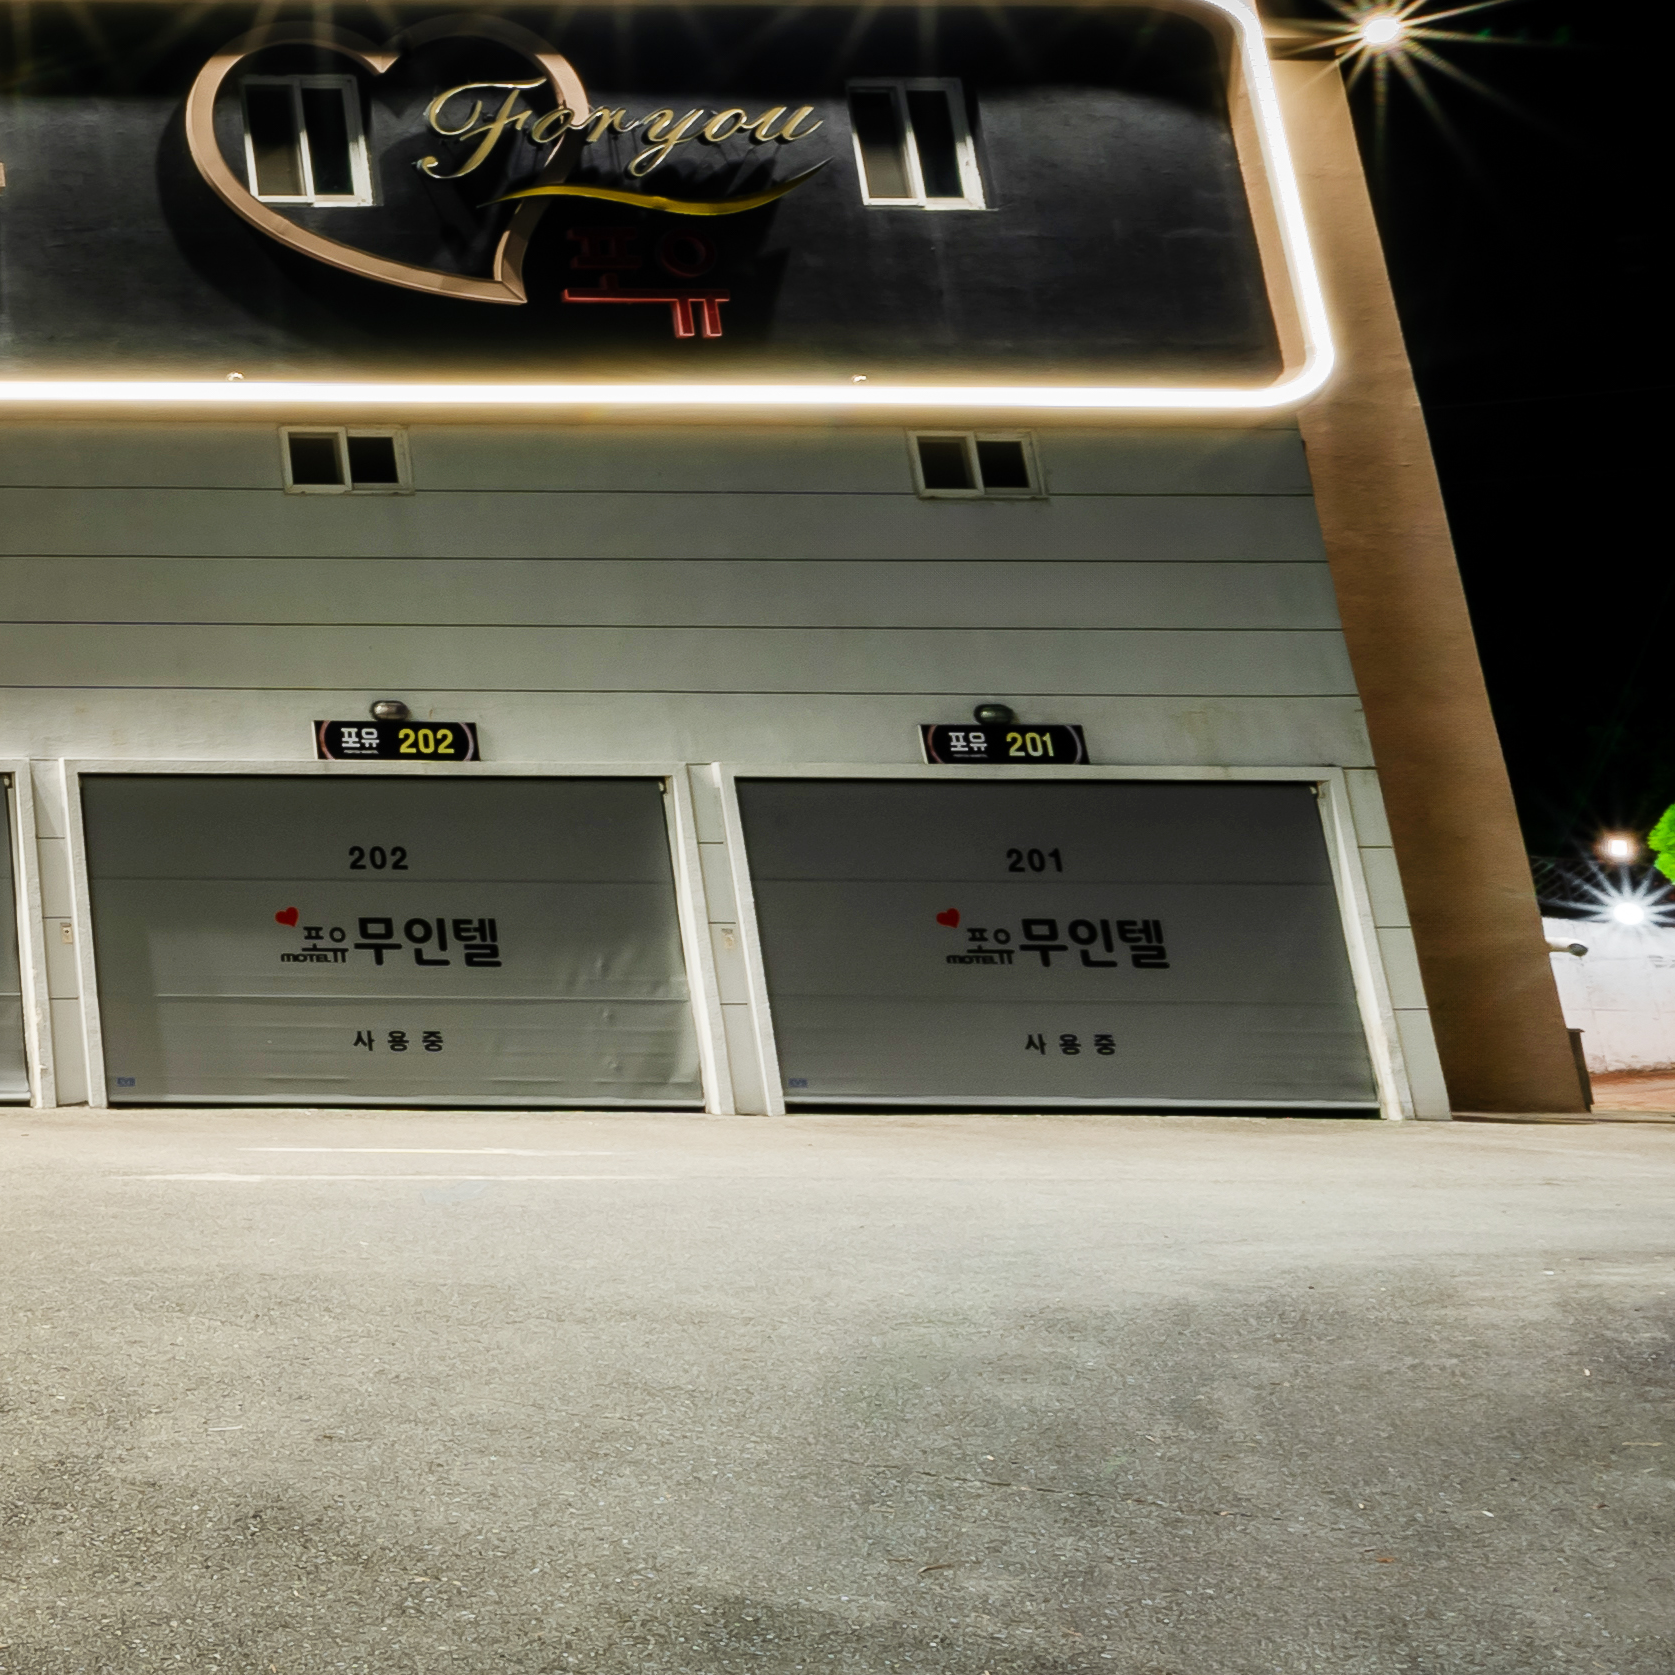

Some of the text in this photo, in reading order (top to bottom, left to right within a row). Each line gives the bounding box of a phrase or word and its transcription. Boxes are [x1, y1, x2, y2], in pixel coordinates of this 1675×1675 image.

[340, 727, 455, 754] 포유 202
[948, 732, 1054, 758] 포유 201
[348, 845, 409, 870] 202
[1006, 847, 1063, 873] 201
[301, 917, 502, 967] 포유 무인텔
[966, 918, 1170, 969] 포유 무인텔
